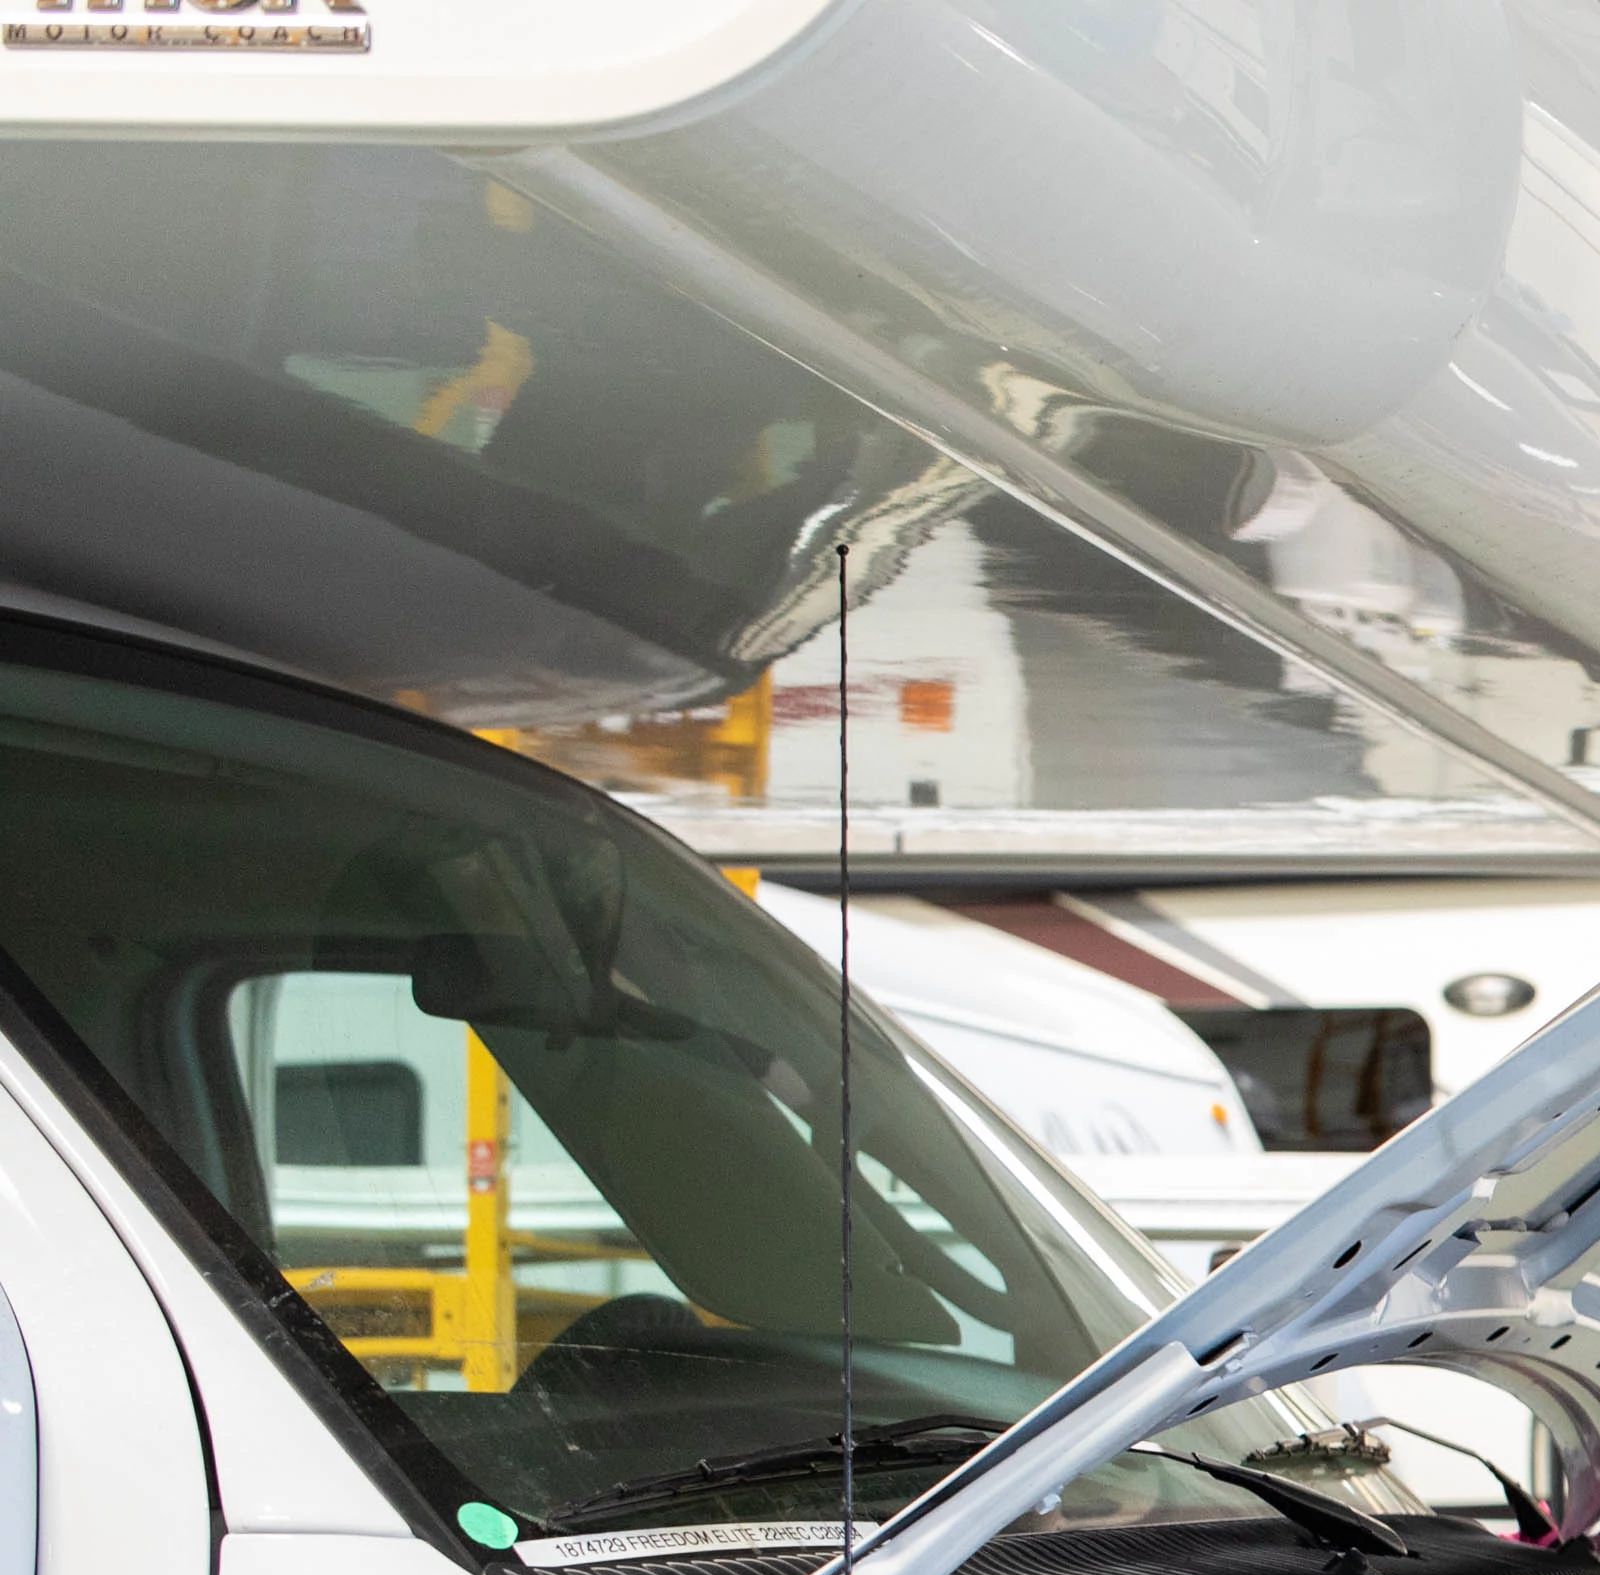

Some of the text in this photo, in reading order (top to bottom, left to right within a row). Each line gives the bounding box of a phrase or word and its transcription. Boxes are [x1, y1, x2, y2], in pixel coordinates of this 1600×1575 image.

[203, 25, 360, 42] COACH
[555, 1537, 627, 1559] 1874729
[628, 1531, 713, 1551] FREEDOM
[712, 1527, 760, 1544] ELITE
[759, 1526, 811, 1541] 22HEC
